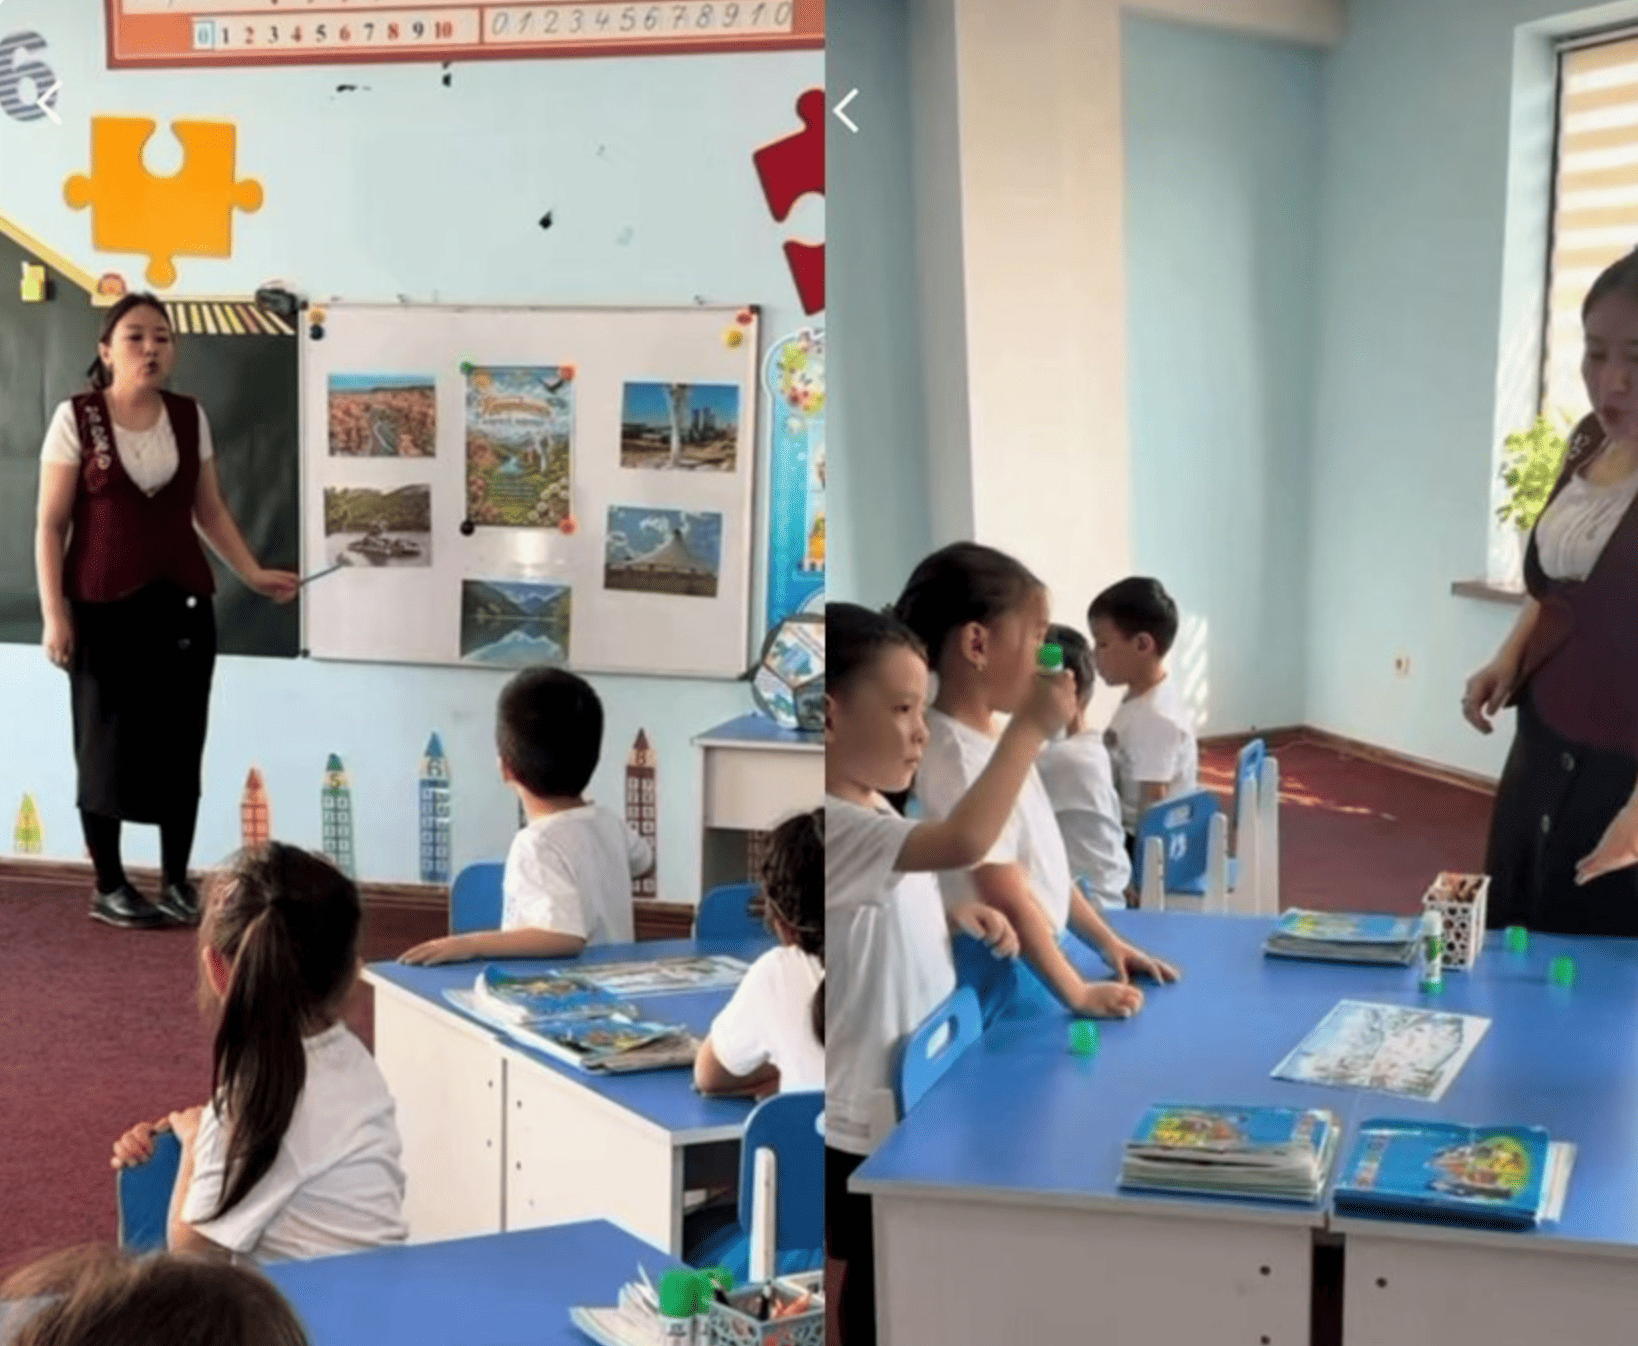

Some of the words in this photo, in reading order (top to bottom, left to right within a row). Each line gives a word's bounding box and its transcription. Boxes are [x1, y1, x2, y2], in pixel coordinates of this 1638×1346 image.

[222, 27, 229, 44] 1
[245, 26, 254, 44] 2
[267, 25, 279, 44] 3
[291, 24, 302, 43] 4
[316, 23, 328, 43] 5
[339, 23, 351, 42] 6
[363, 22, 375, 41] 7
[387, 22, 399, 40] 8
[412, 20, 424, 39] 9
[434, 20, 453, 40] 10
[491, 11, 509, 35] 0
[518, 10, 533, 35] 1
[543, 9, 559, 34] 2
[568, 8, 584, 34] 3
[595, 8, 610, 31] 4
[619, 6, 636, 32] 5
[643, 5, 660, 31] 6
[671, 4, 687, 30] 7
[695, 3, 714, 29] 8
[722, 2, 740, 28] 9
[0, 30, 58, 121] 6
